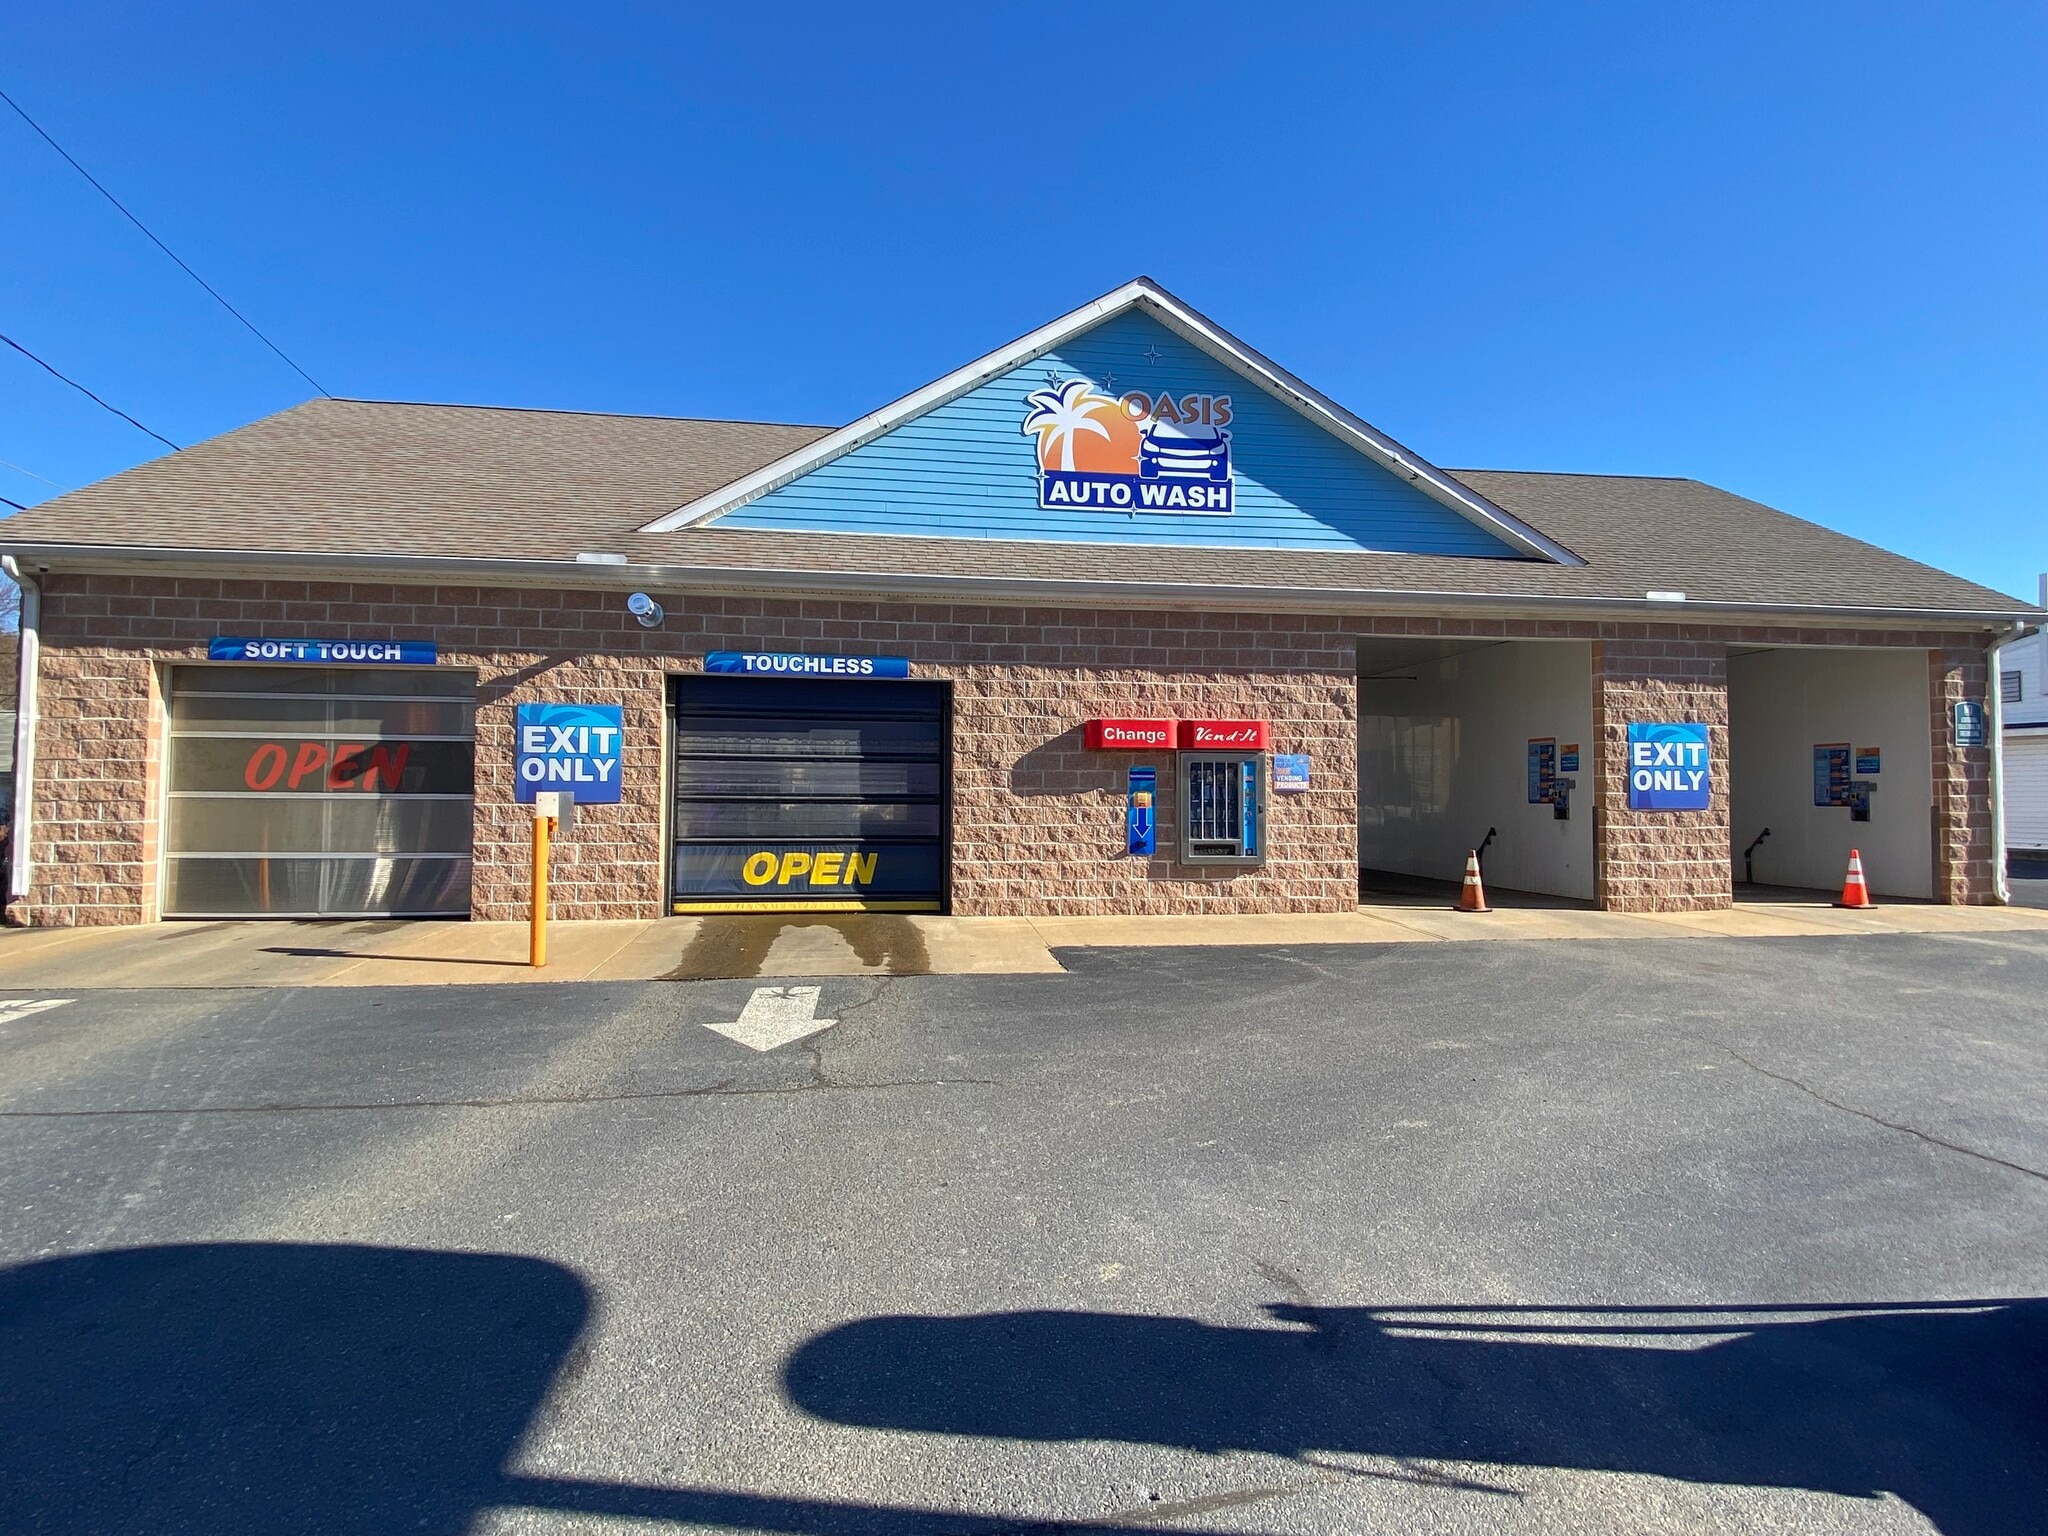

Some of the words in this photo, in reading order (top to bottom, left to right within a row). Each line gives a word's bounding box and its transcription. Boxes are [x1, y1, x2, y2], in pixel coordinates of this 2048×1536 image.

[1120, 393, 1231, 425] OASIS
[1049, 481, 1131, 505] AUTO
[1140, 484, 1227, 508] WASH
[244, 641, 310, 661] SOFT
[318, 642, 402, 662] TOUCH
[742, 655, 874, 675] TOUCHLESS
[523, 726, 618, 754] EXIT
[1104, 727, 1167, 743] Change
[1195, 726, 1258, 742] Vend-It
[1633, 742, 1705, 766] EXIT
[244, 743, 410, 792] OPEN
[521, 757, 617, 783] ONLY
[1633, 770, 1705, 792] ONLY
[742, 851, 879, 886] OPEN
